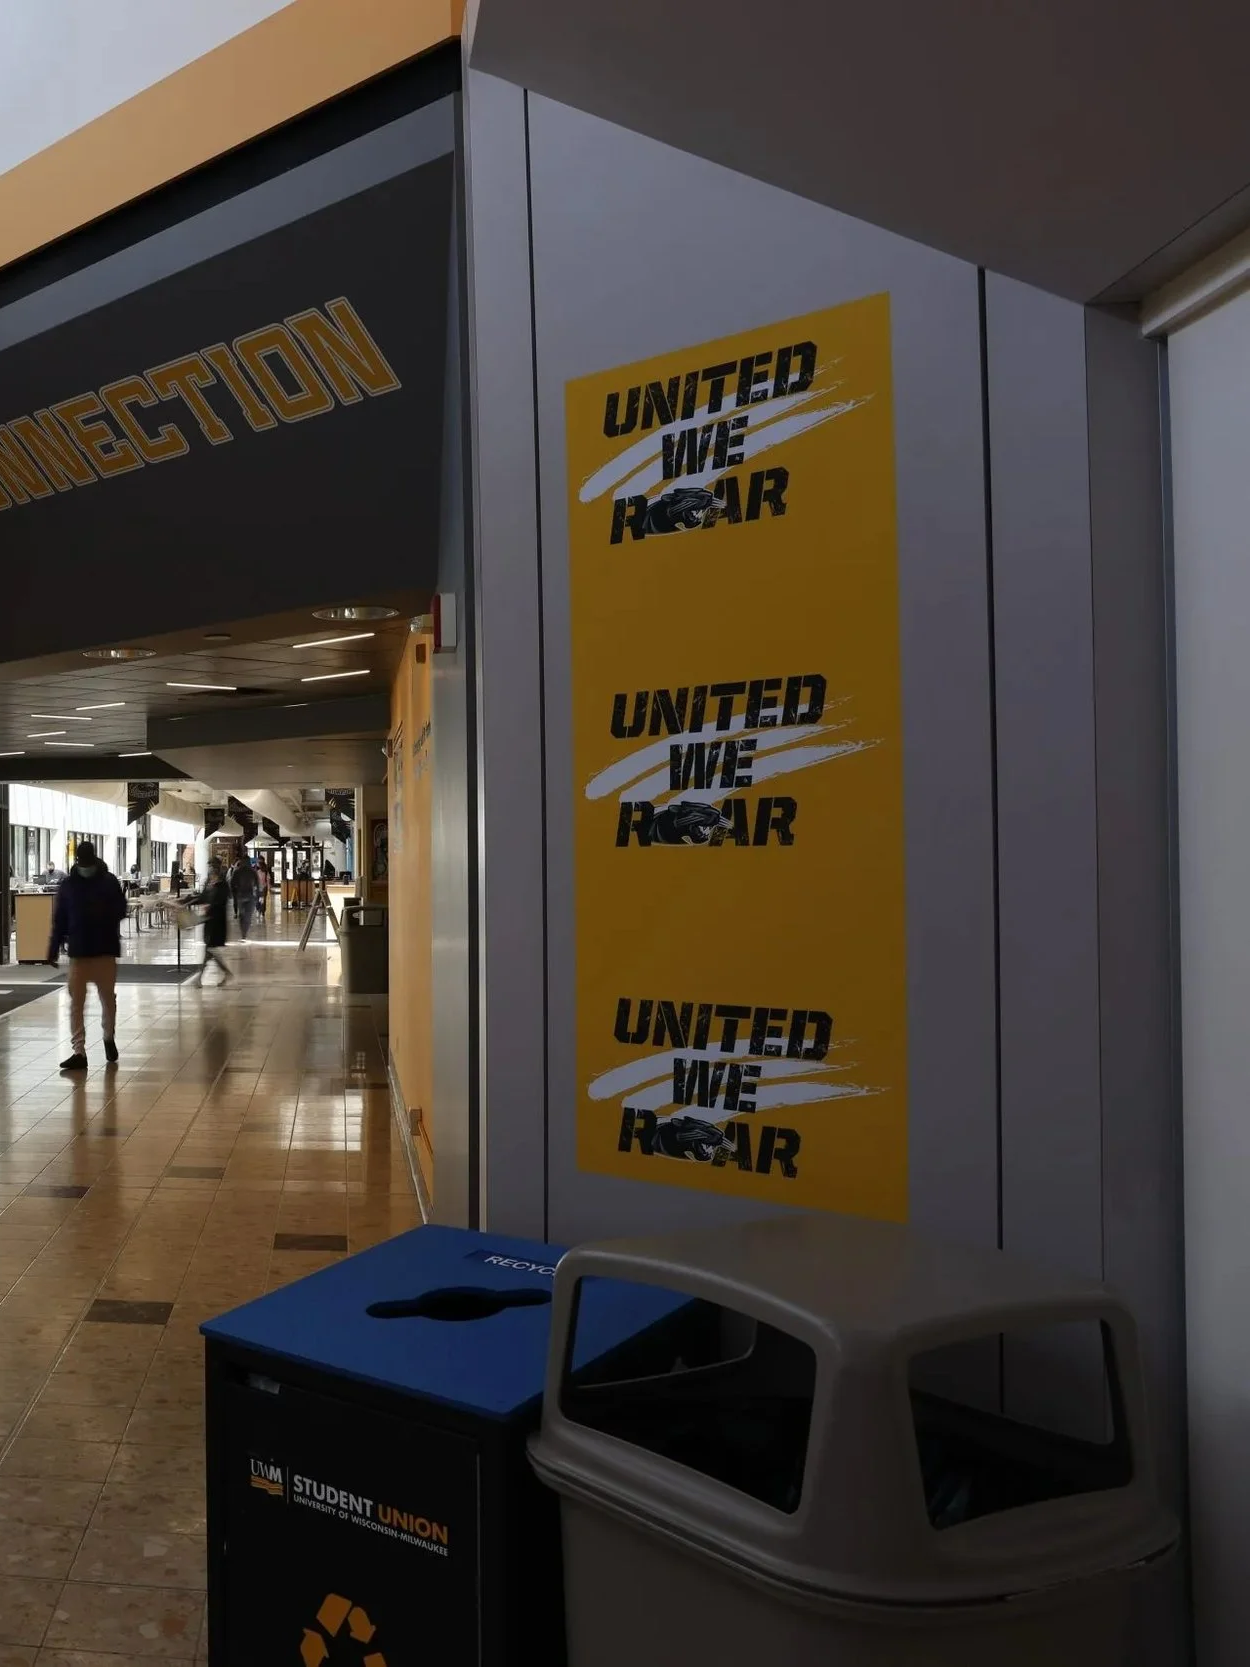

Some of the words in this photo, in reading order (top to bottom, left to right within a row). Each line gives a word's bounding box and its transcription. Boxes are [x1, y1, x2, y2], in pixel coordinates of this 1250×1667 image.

[603, 341, 817, 438] UNITED
[662, 415, 749, 480] WE
[610, 673, 827, 739] UNITED
[669, 738, 758, 790] WE
[613, 997, 834, 1061] UNITED
[672, 1058, 762, 1113] WE
[484, 1255, 556, 1276] RECYC
[293, 1474, 373, 1518] STUDENT
[378, 1503, 448, 1545] UNION
[293, 1494, 336, 1515] UNIVERSITY
[338, 1510, 349, 1520] OF
[351, 1513, 448, 1557] WISCONSIN-MILWAUKEE
